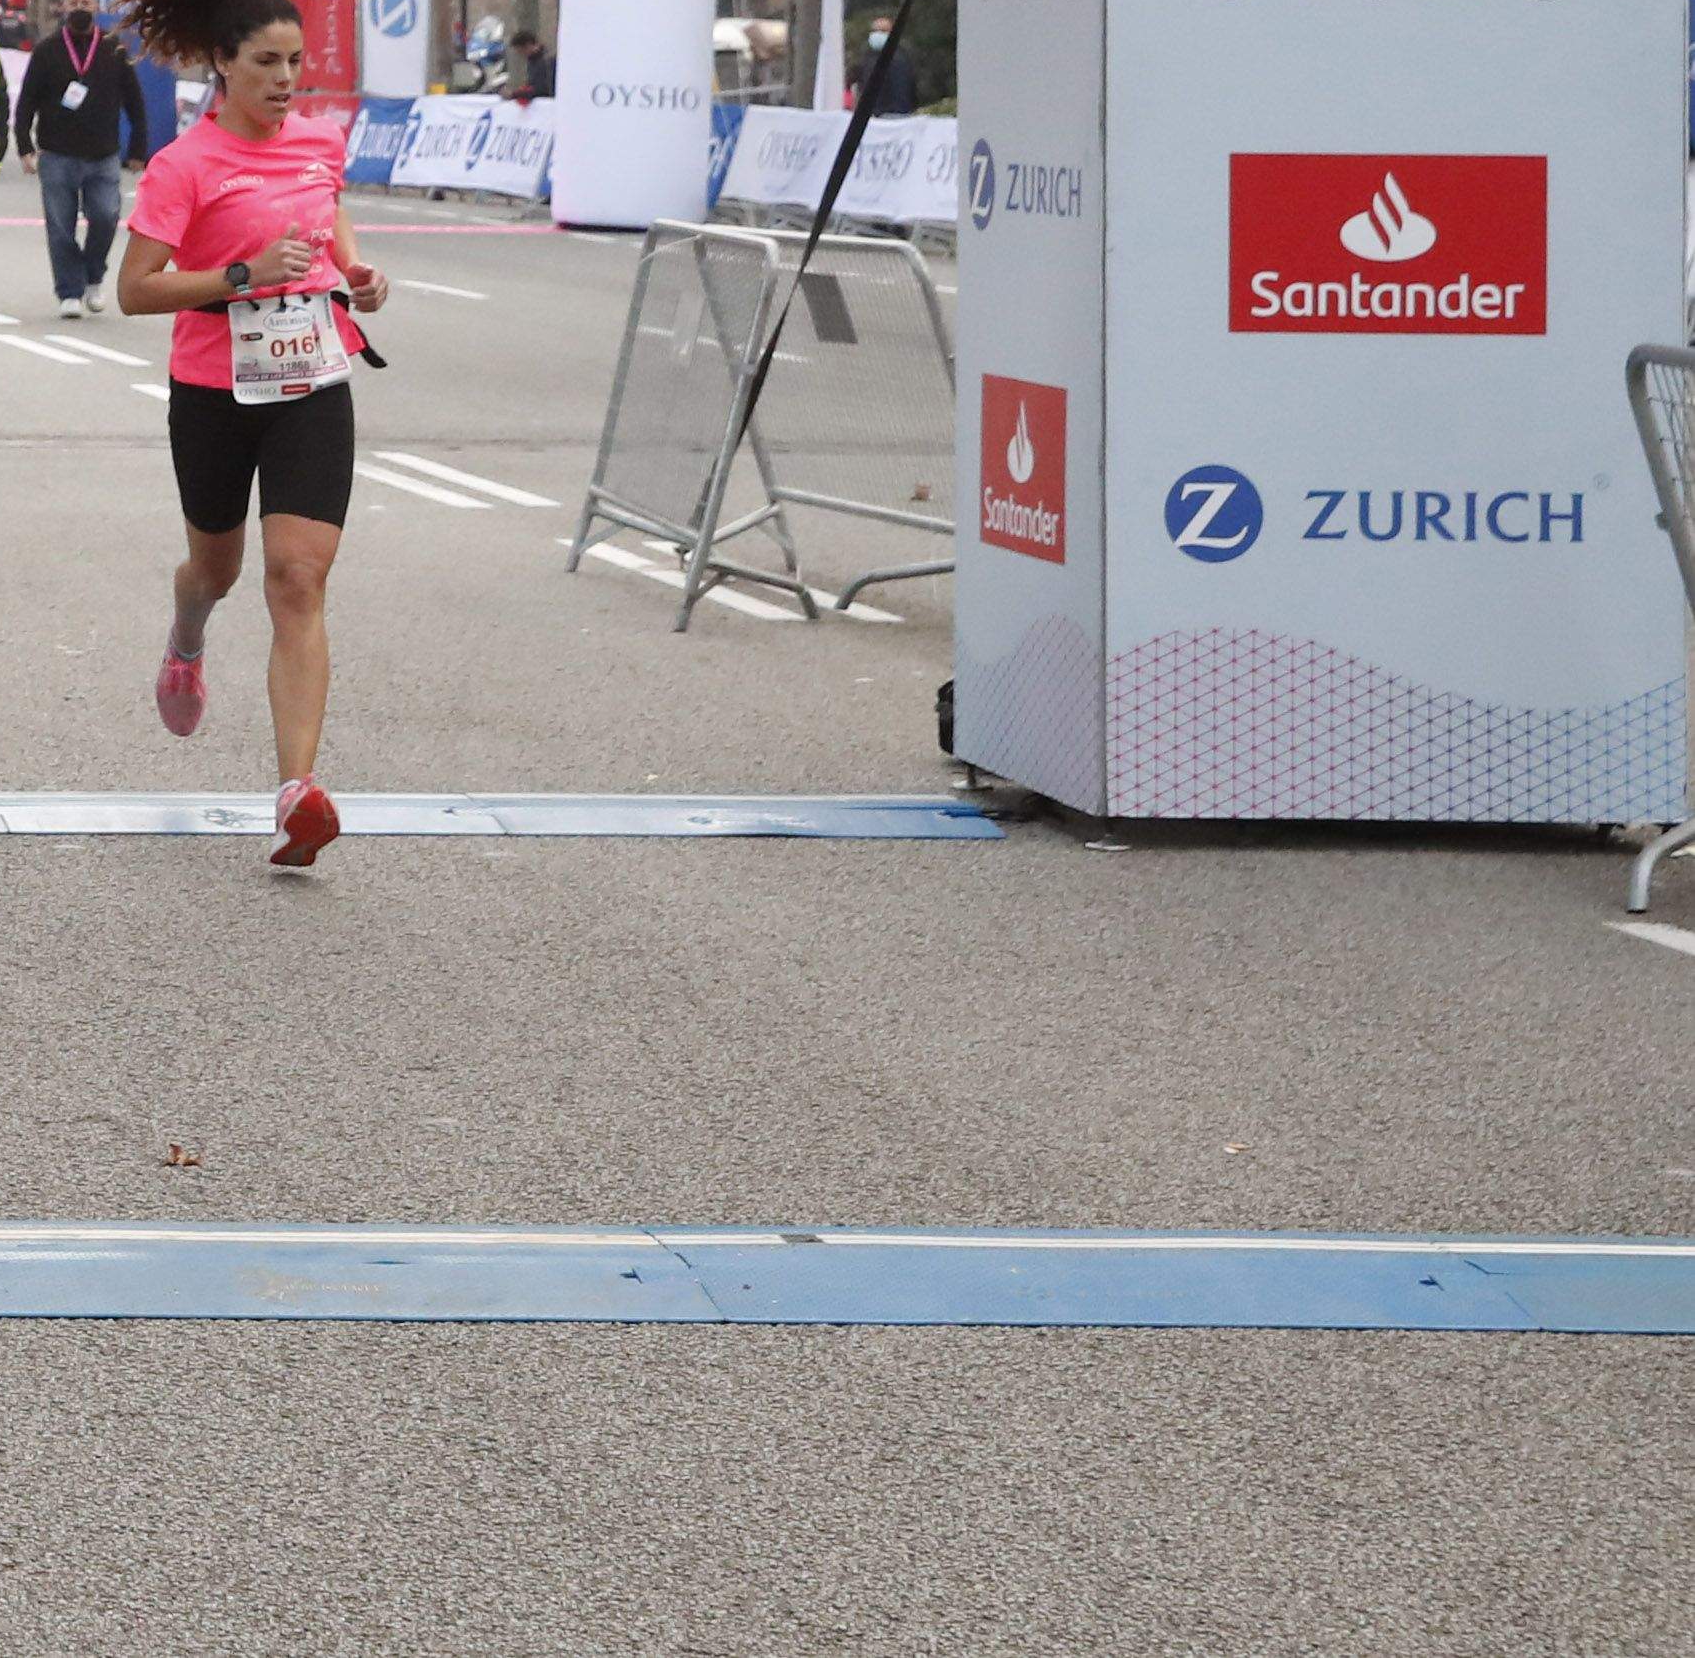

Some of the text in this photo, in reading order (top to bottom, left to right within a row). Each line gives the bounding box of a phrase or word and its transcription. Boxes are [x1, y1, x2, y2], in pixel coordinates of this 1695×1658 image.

[590, 82, 702, 112] OYSHO
[1004, 162, 1082, 219] ZURICH
[1250, 270, 1525, 320] Santander
[983, 486, 1060, 548] Santander
[1302, 490, 1584, 544] ZURICH
